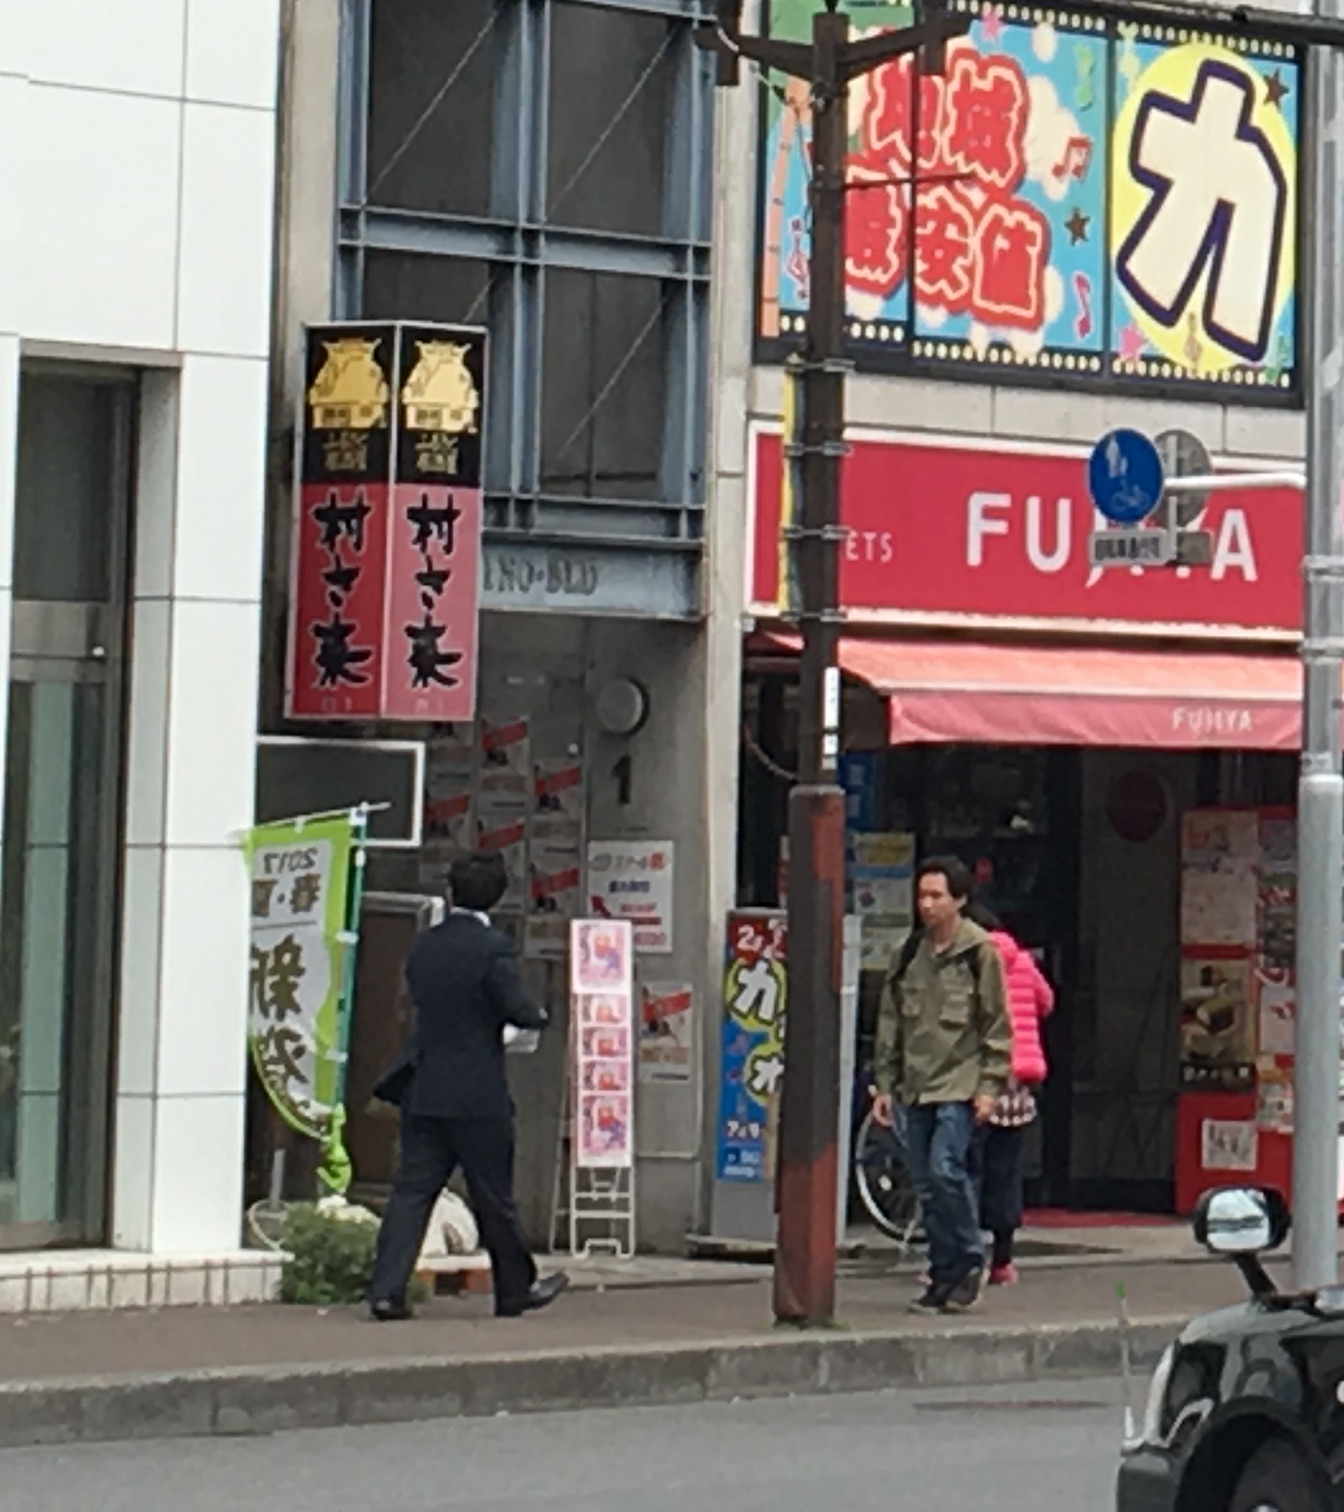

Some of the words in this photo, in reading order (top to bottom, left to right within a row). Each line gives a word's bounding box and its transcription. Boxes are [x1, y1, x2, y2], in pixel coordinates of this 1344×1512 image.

[312, 491, 373, 688] 村さ来
[406, 491, 463, 688] 村さ来
